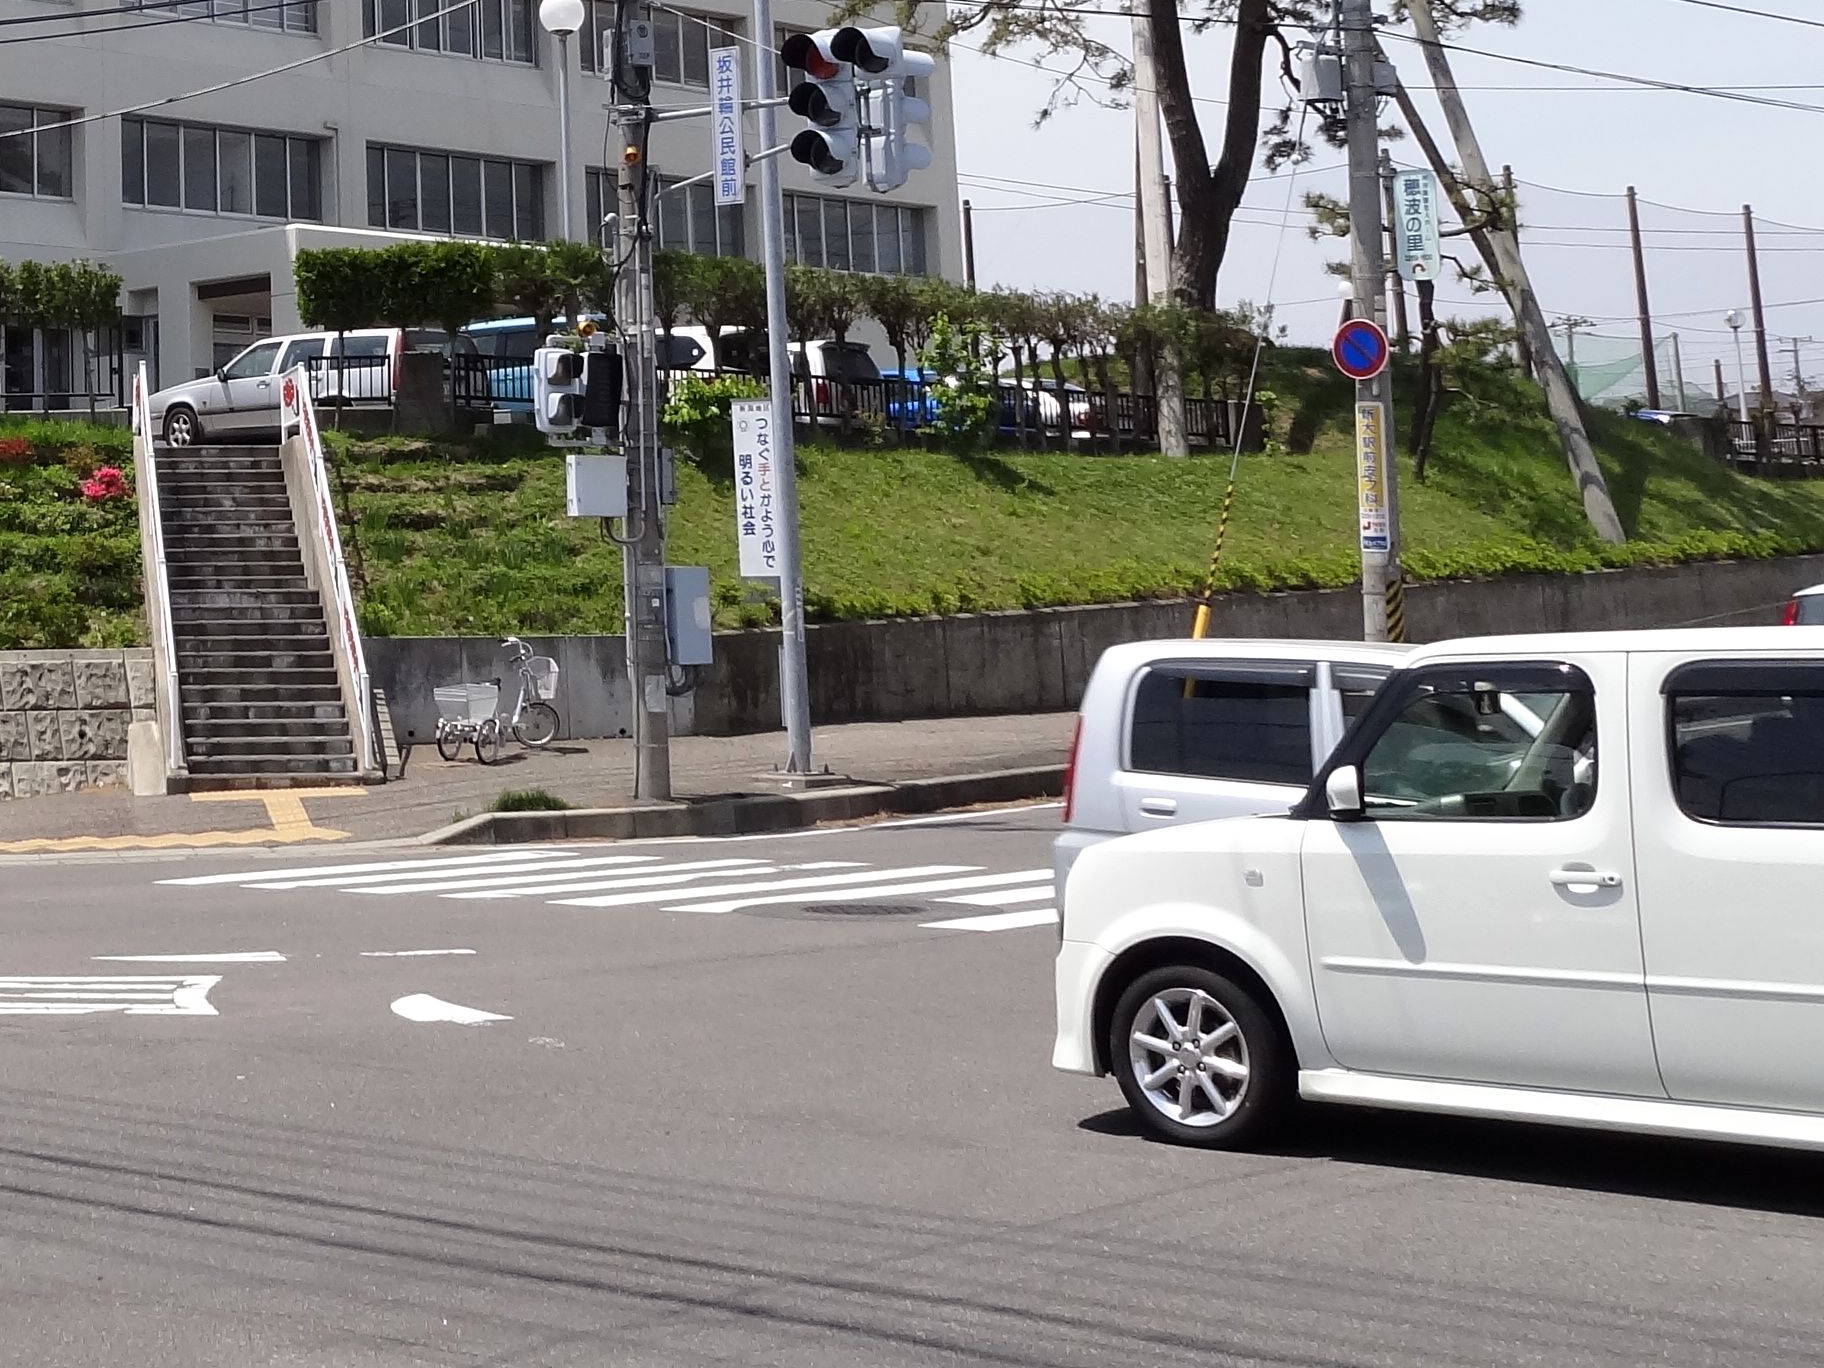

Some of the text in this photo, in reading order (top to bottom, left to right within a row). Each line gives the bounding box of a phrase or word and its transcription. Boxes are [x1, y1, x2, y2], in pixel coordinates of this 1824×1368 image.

[716, 55, 737, 197] 坂井輪公民館前
[738, 453, 757, 536] 明るい社会
[755, 417, 777, 568] つなぐ手とかよう心で
